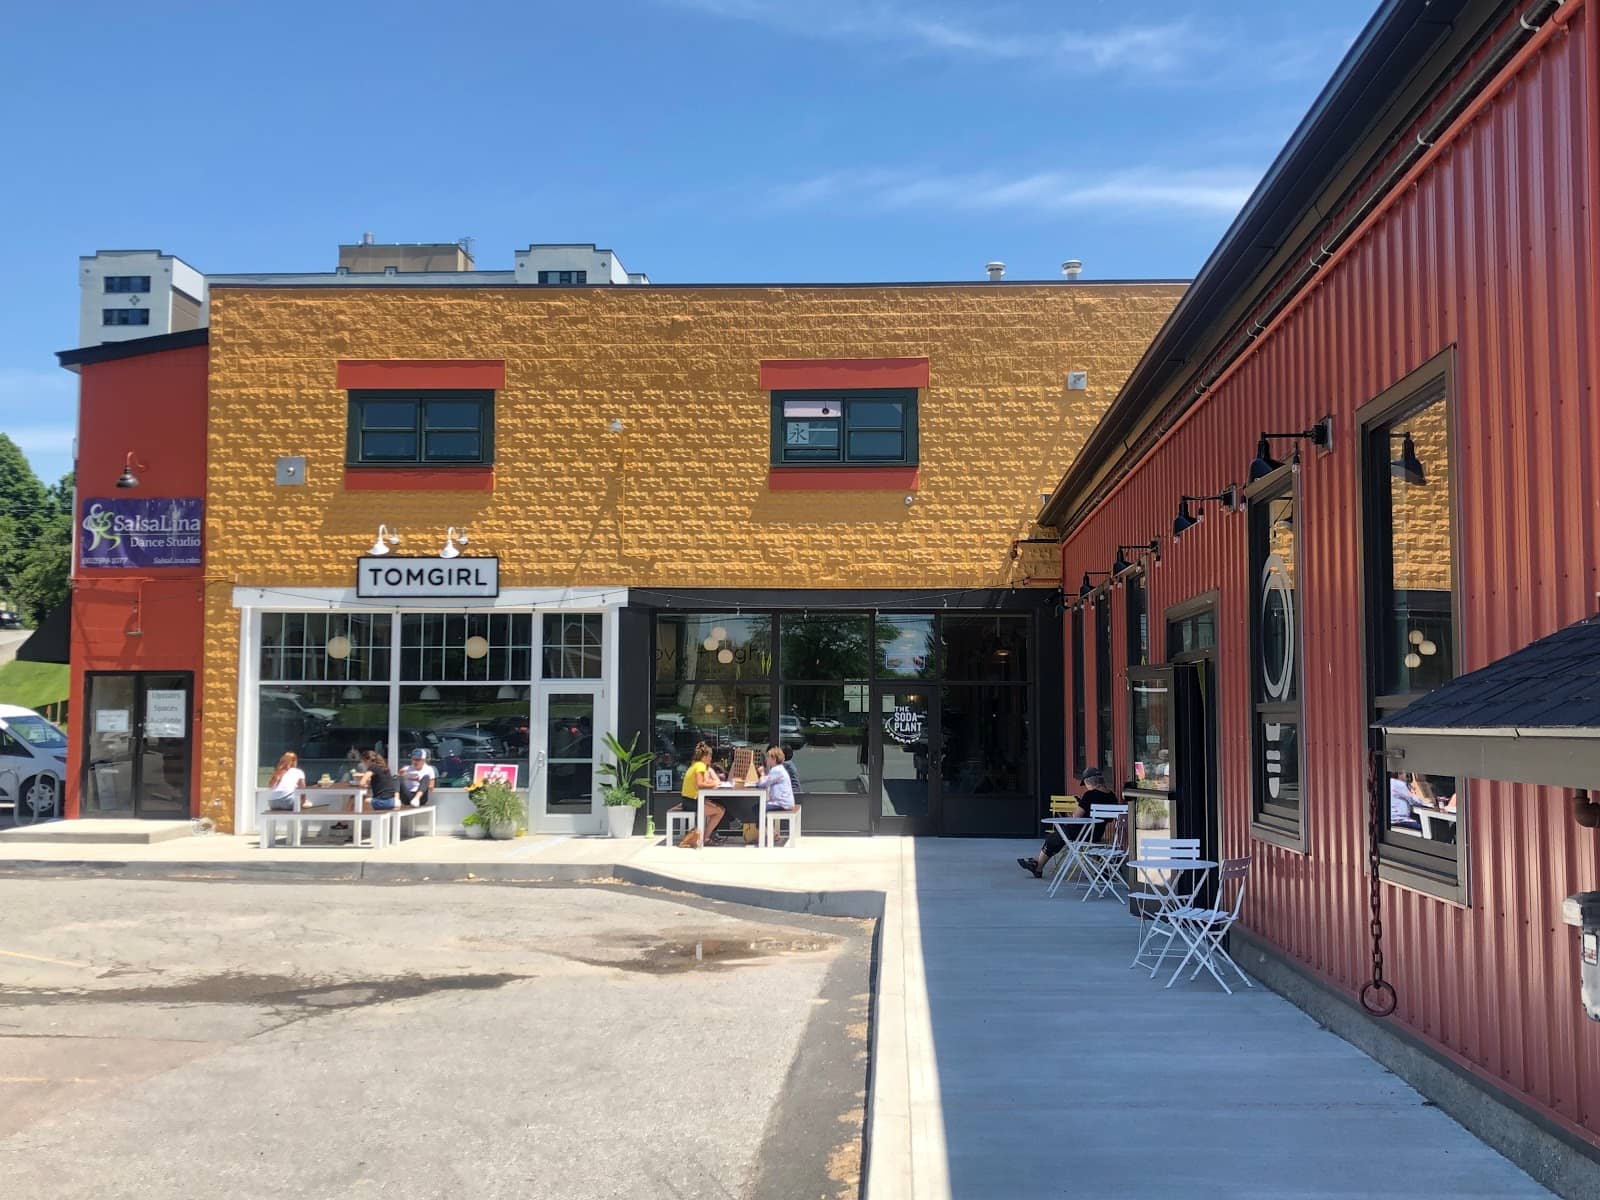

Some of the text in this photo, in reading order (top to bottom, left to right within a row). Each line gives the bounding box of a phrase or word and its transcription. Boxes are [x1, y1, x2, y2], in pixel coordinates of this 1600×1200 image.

[130, 536, 201, 547] Dance Studio
[368, 568, 488, 586] TOMGIRL
[894, 712, 918, 722] SODA
[894, 722, 922, 732] PLANT
